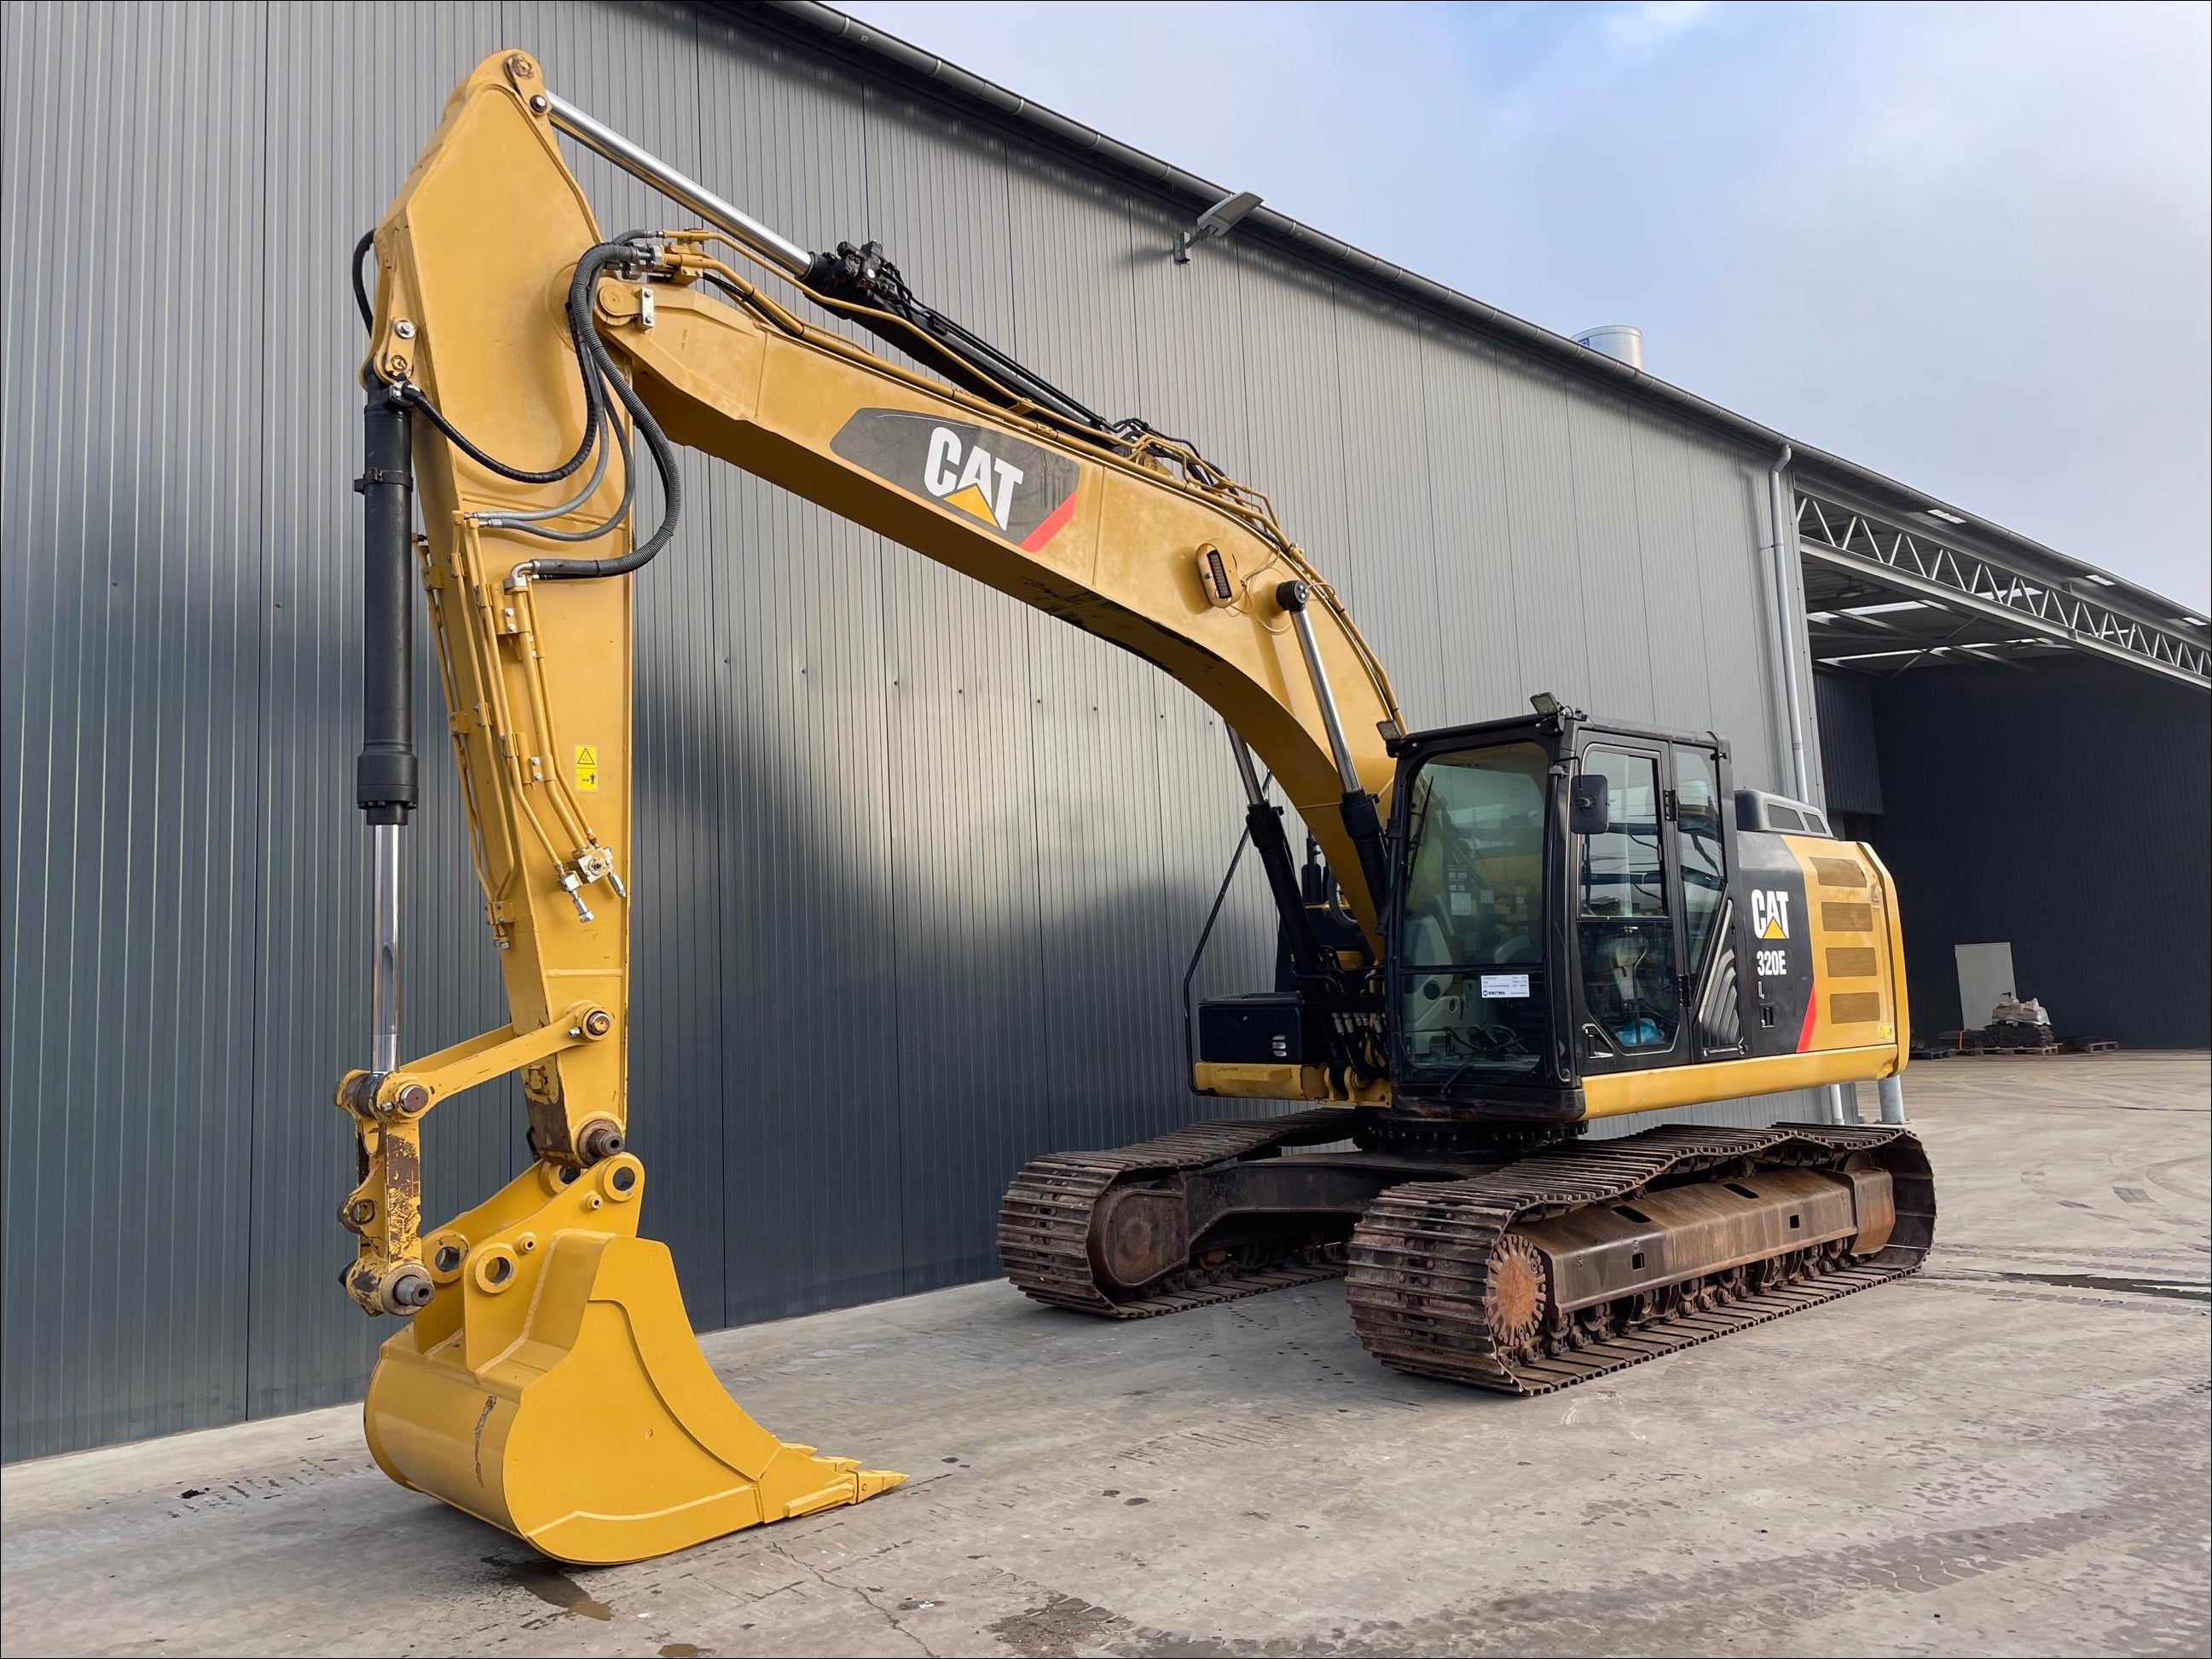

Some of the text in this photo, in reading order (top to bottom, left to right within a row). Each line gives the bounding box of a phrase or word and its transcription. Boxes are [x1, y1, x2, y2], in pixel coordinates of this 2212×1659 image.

[924, 426, 1023, 531] CAT
[1751, 889, 1789, 939] CAT
[1757, 951, 1786, 976] 320E
